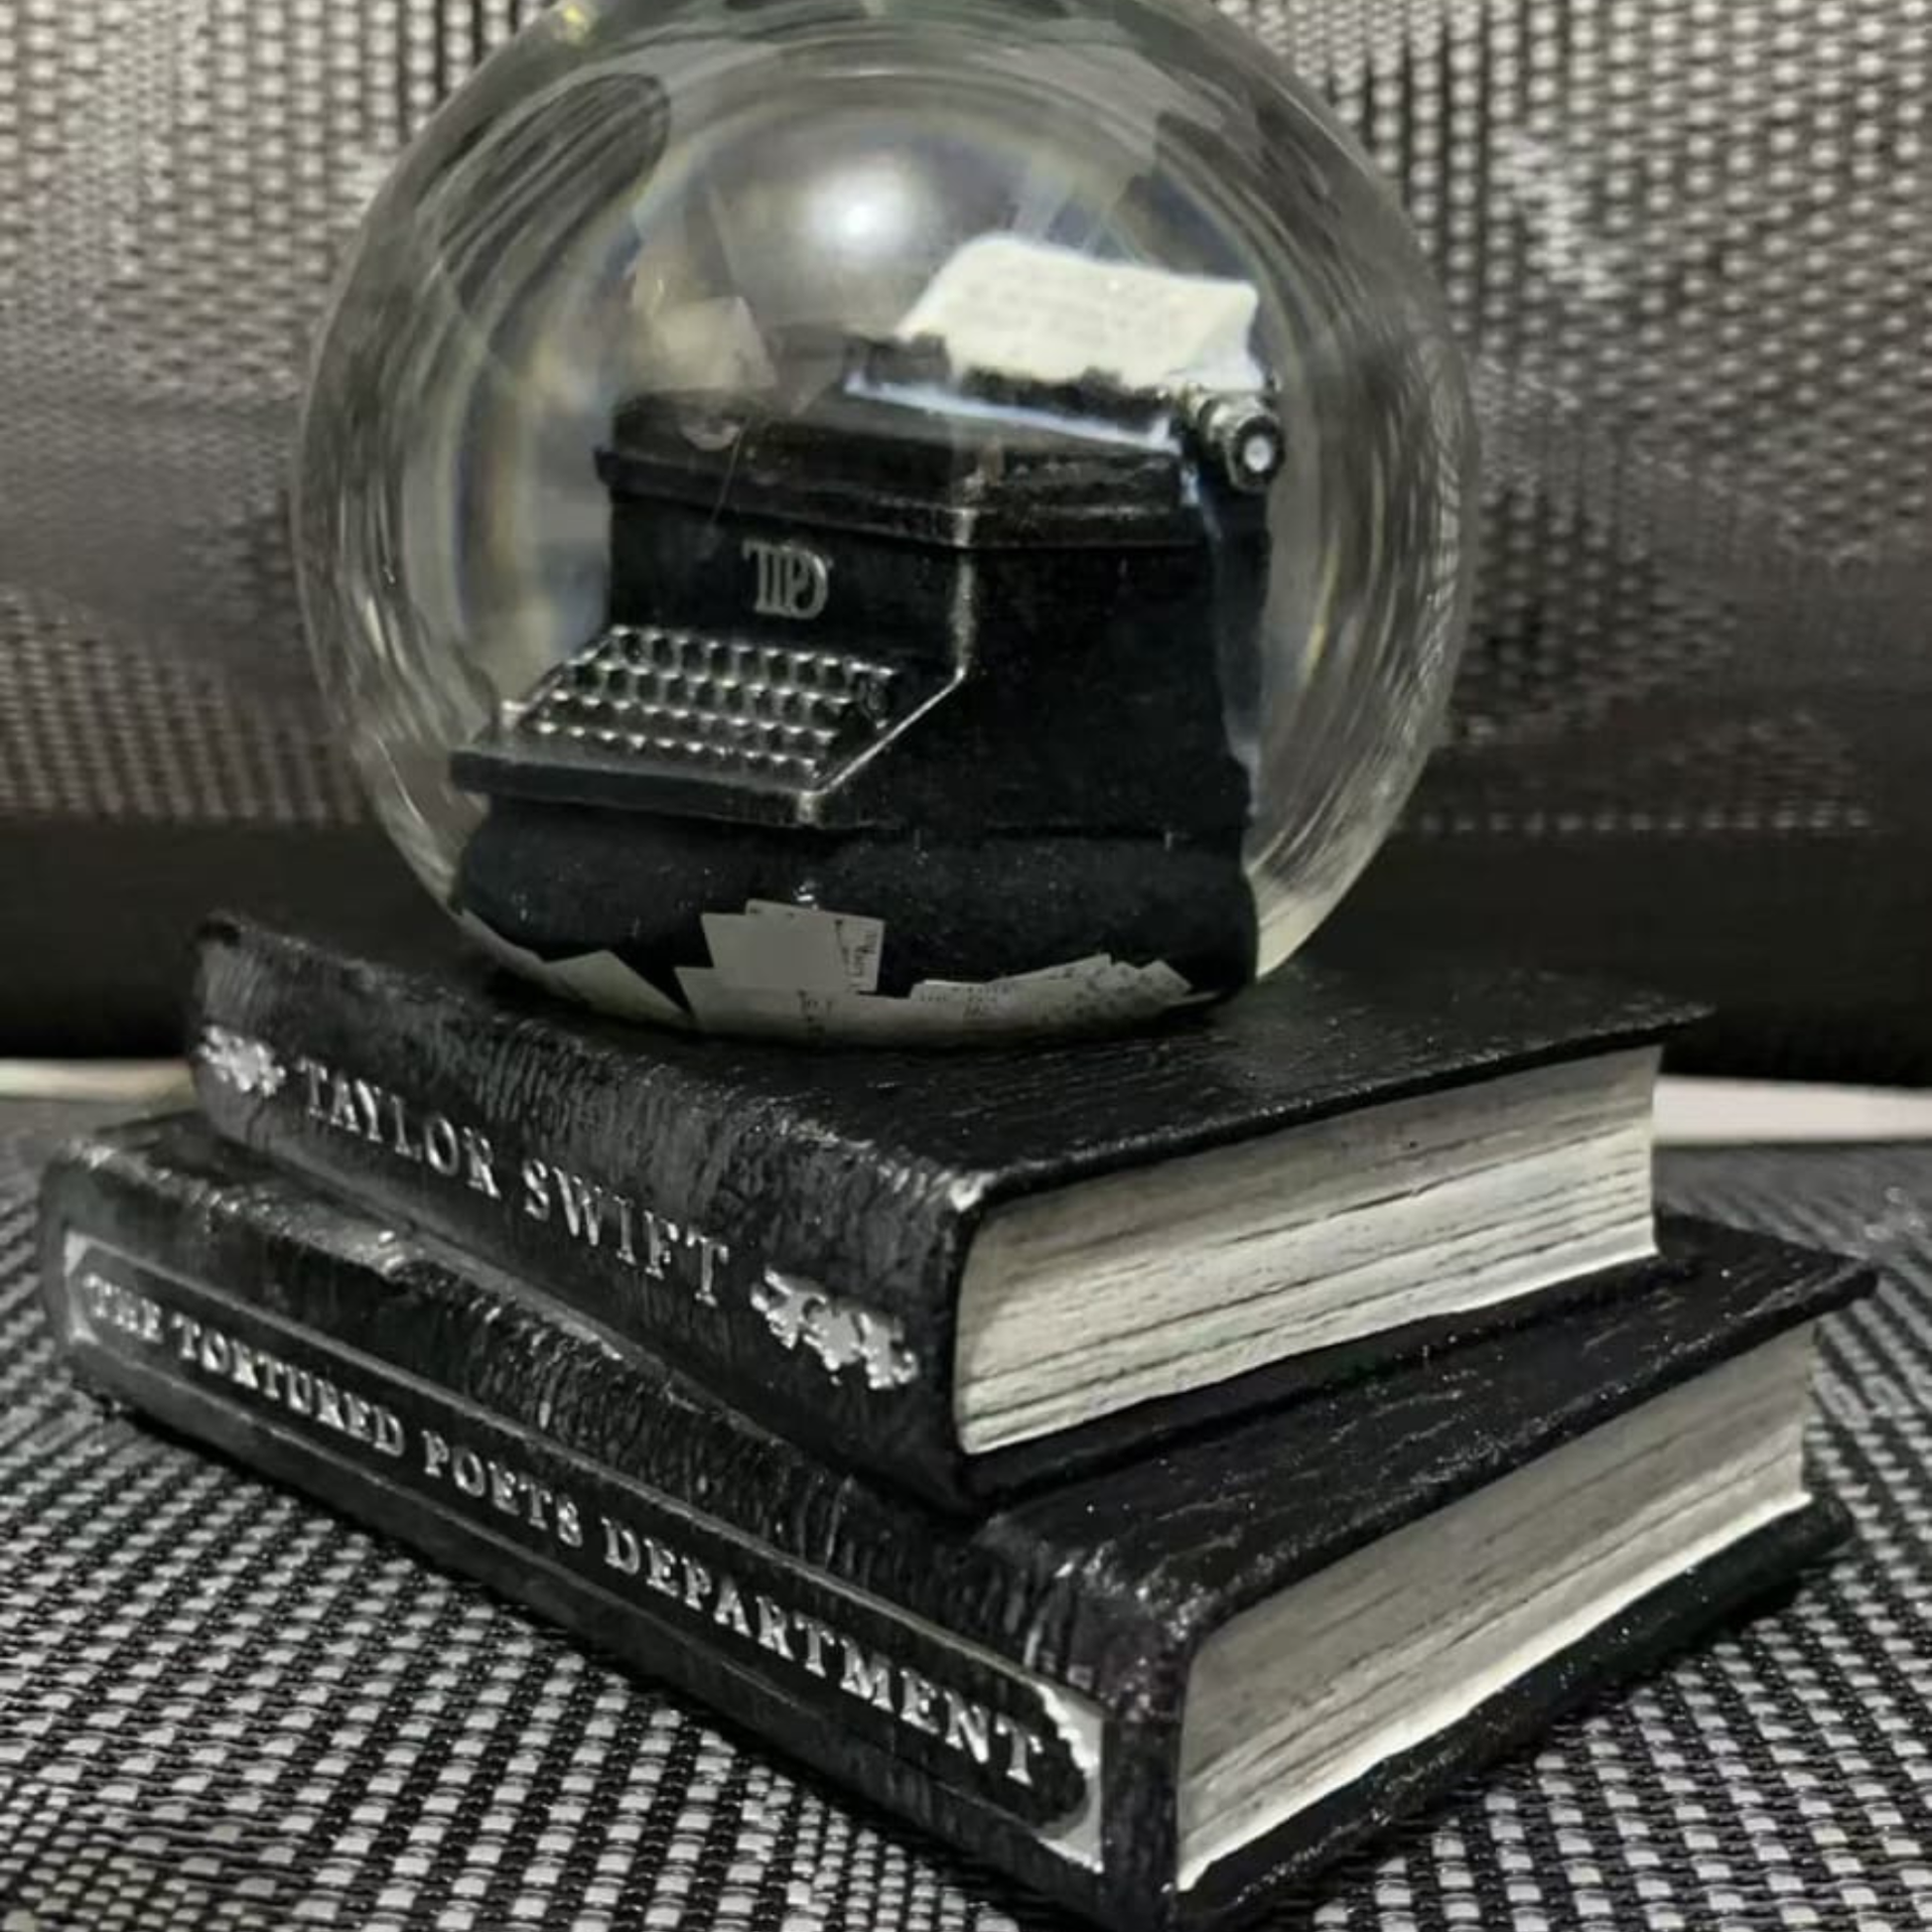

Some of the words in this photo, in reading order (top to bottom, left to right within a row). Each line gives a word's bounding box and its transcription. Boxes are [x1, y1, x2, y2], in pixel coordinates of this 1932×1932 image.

[299, 1056, 500, 1198] TAYLOR
[522, 1159, 729, 1308] SWIFT
[170, 1311, 405, 1457] TORTURED
[421, 1429, 584, 1548] POETS
[600, 1516, 1045, 1786] DEPARTMENT
